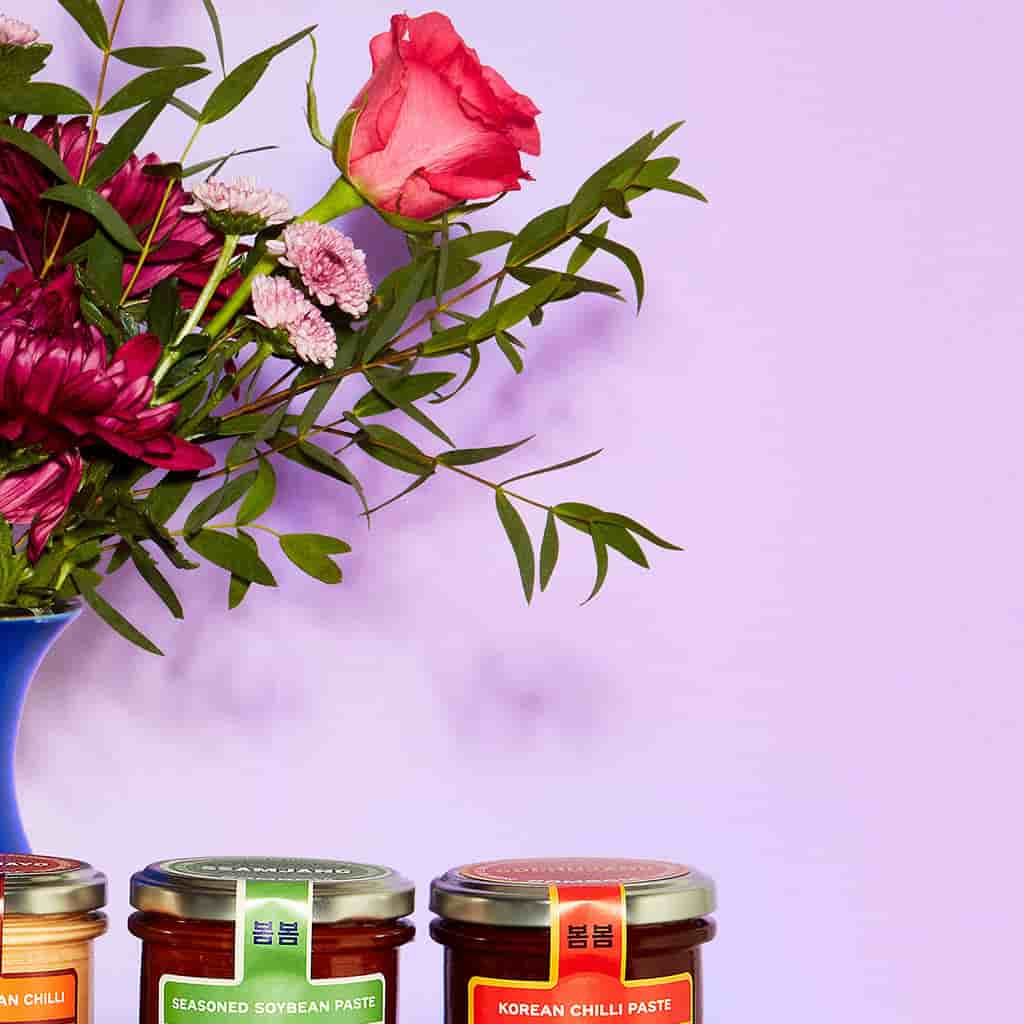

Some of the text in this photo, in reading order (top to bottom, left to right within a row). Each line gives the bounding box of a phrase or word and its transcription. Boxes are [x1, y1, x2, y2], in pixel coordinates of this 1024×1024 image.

[23, 991, 66, 1006] CHILLI
[172, 995, 376, 1015] SEASONED SOYBEAN PASTE
[498, 998, 672, 1017] KOREAN CHILLI PASTE
